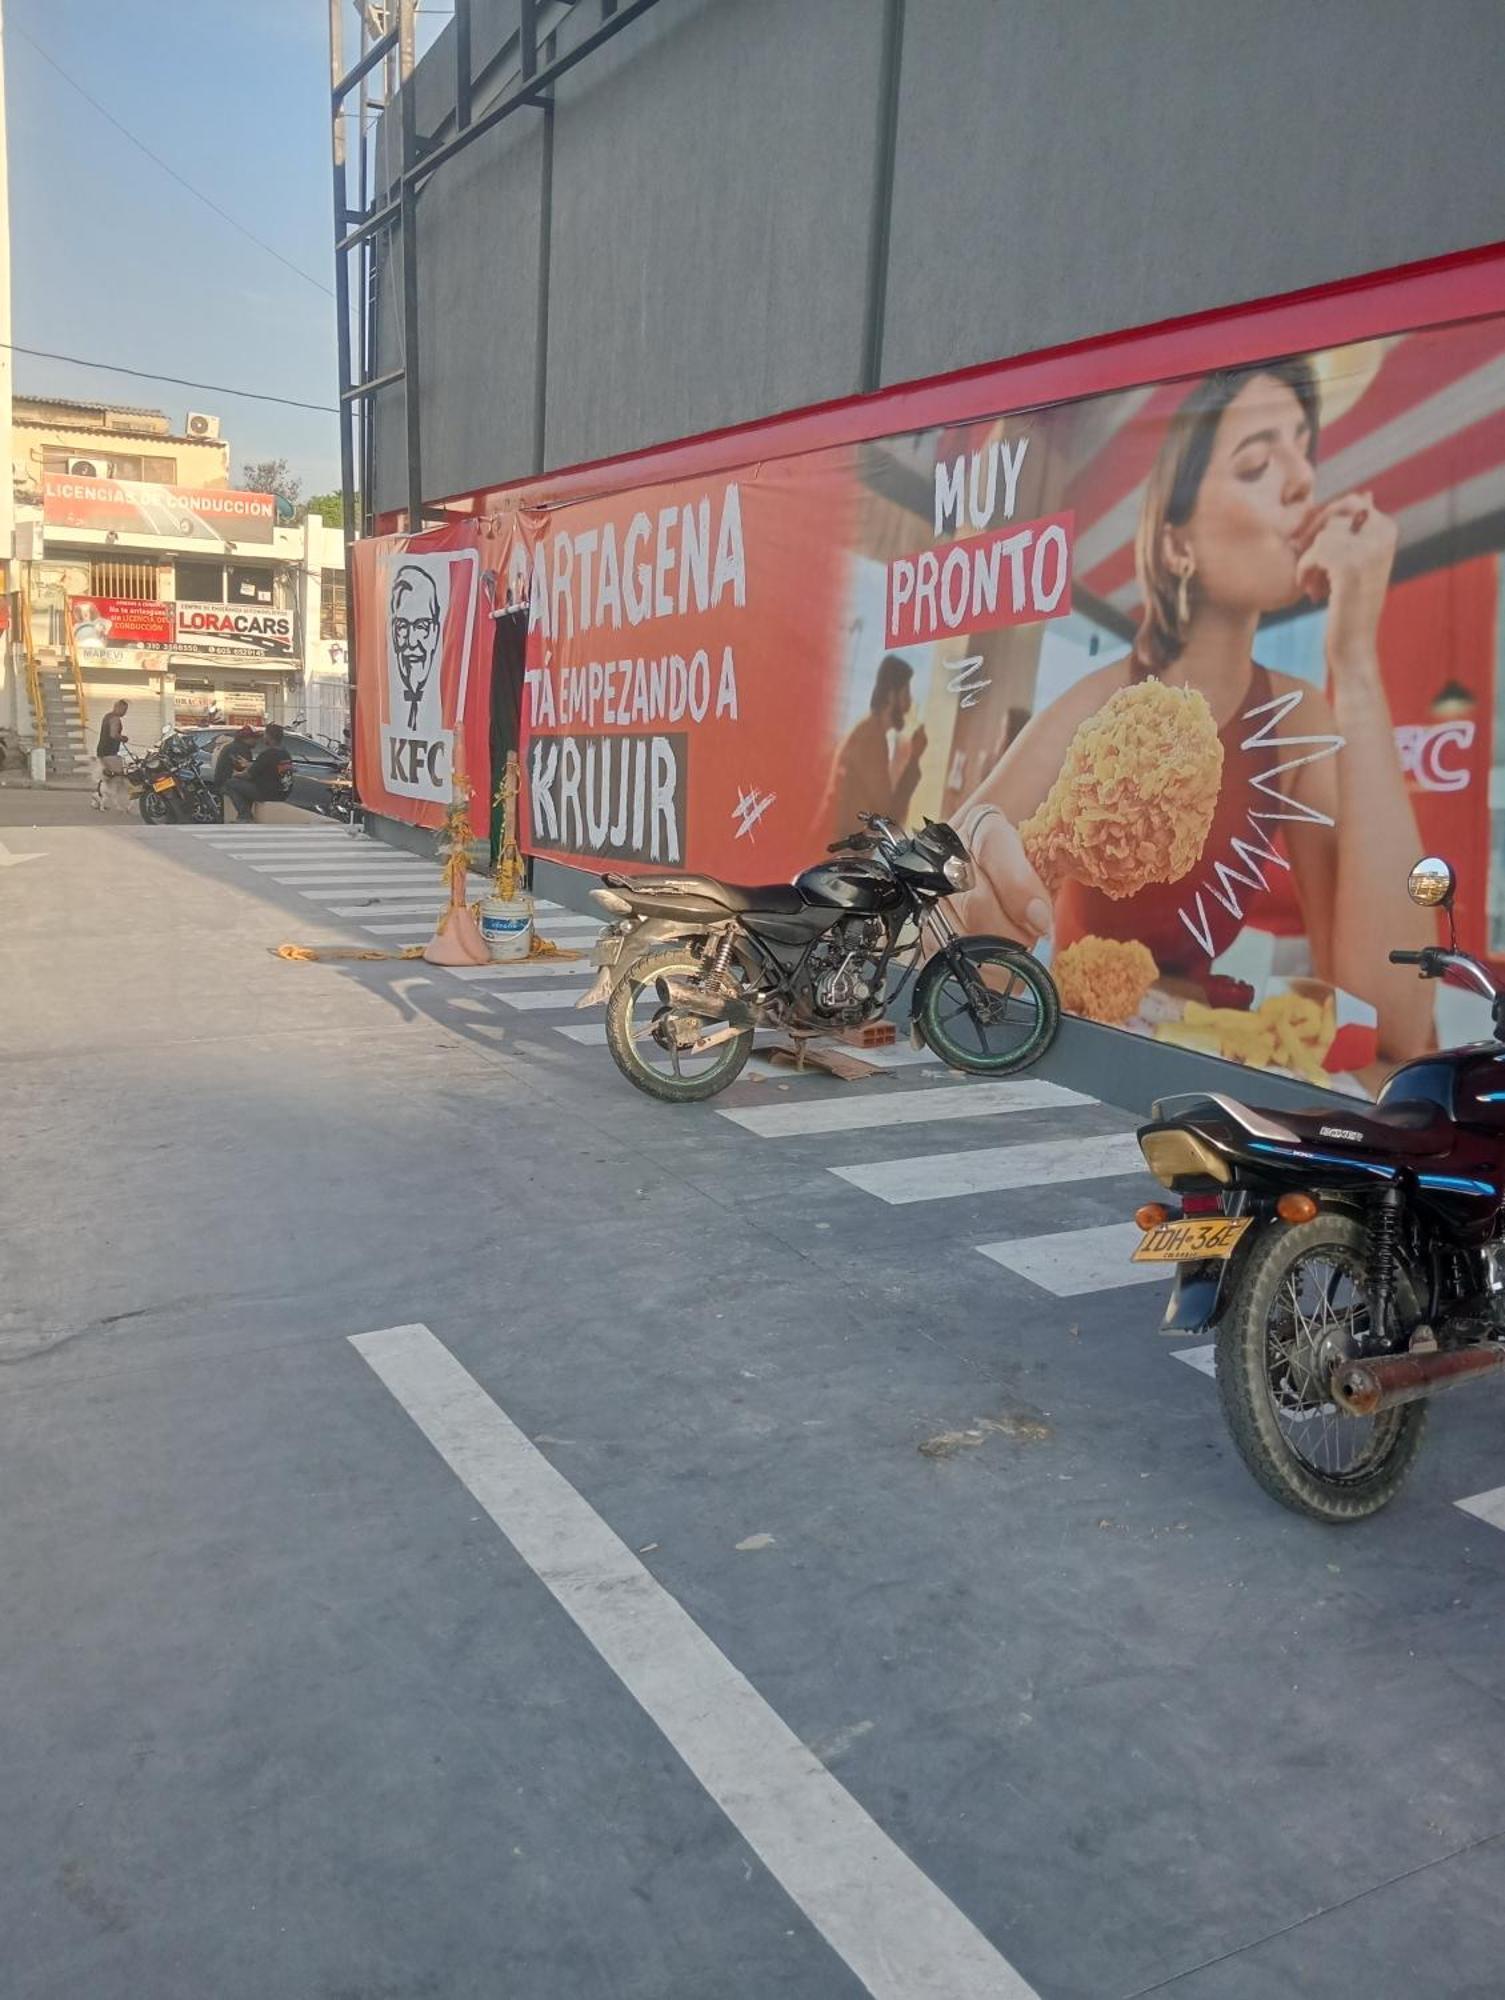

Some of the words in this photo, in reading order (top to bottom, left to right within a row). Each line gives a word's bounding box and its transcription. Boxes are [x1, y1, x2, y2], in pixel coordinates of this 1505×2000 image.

[46, 484, 136, 503] LICENCIAS
[933, 436, 1029, 538] MUY
[891, 524, 1068, 636] PRONTO
[179, 611, 290, 634] LORACARS
[559, 648, 709, 729] EMPEZANDO
[716, 646, 738, 721] A
[390, 735, 445, 788] KFC
[532, 735, 680, 863] KRUJIR
